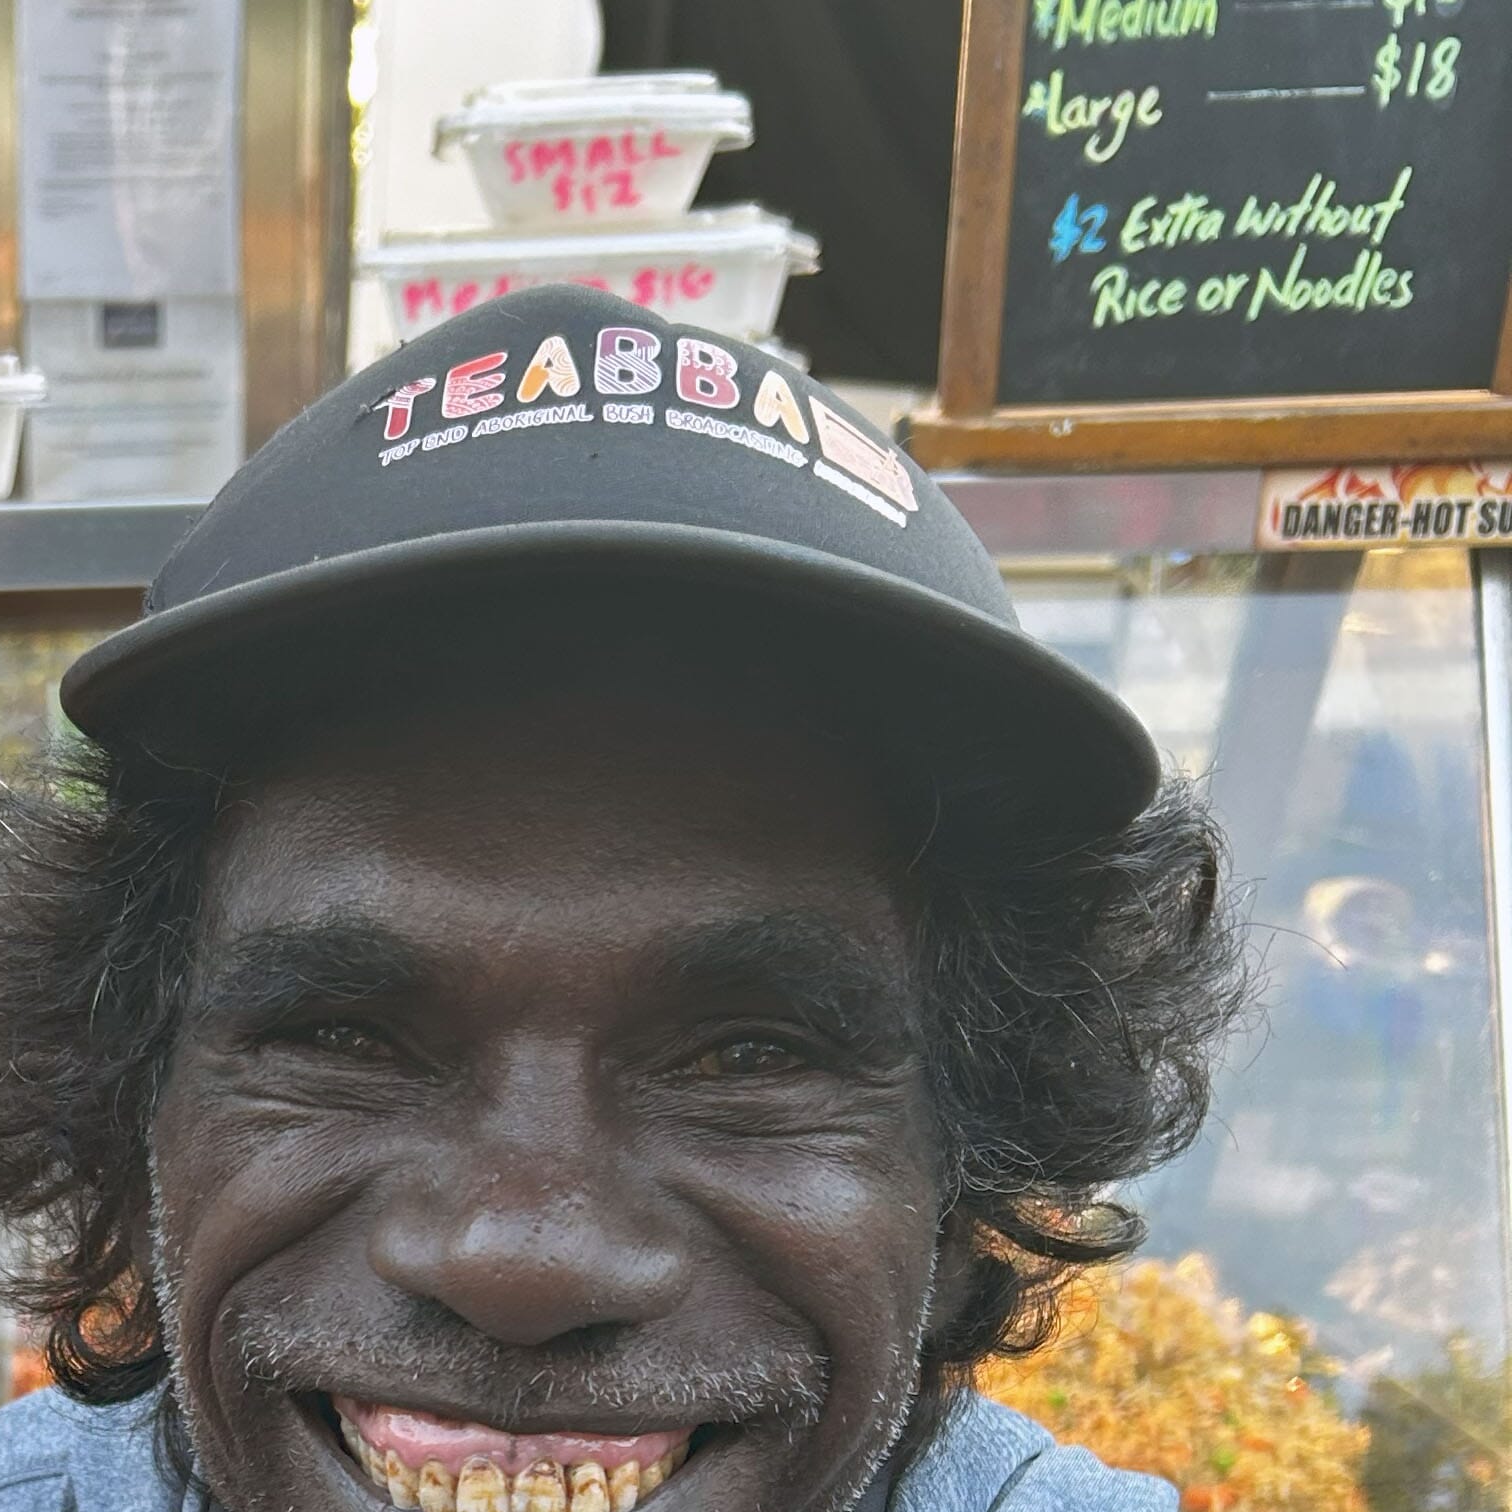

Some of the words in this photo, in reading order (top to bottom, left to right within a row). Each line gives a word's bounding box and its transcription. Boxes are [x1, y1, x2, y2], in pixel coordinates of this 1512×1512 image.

[1372, 32, 1463, 110] $18
[504, 131, 682, 186] SMALL
[1047, 192, 1109, 264] $2
[1120, 191, 1225, 255] Extra
[1090, 264, 1188, 329] Rice
[1196, 273, 1250, 313] or
[1245, 242, 1415, 322] Noodles
[378, 327, 810, 440] TEABBA
[378, 438, 421, 467] TOP
[422, 424, 469, 452] END
[602, 402, 655, 426] BUSH
